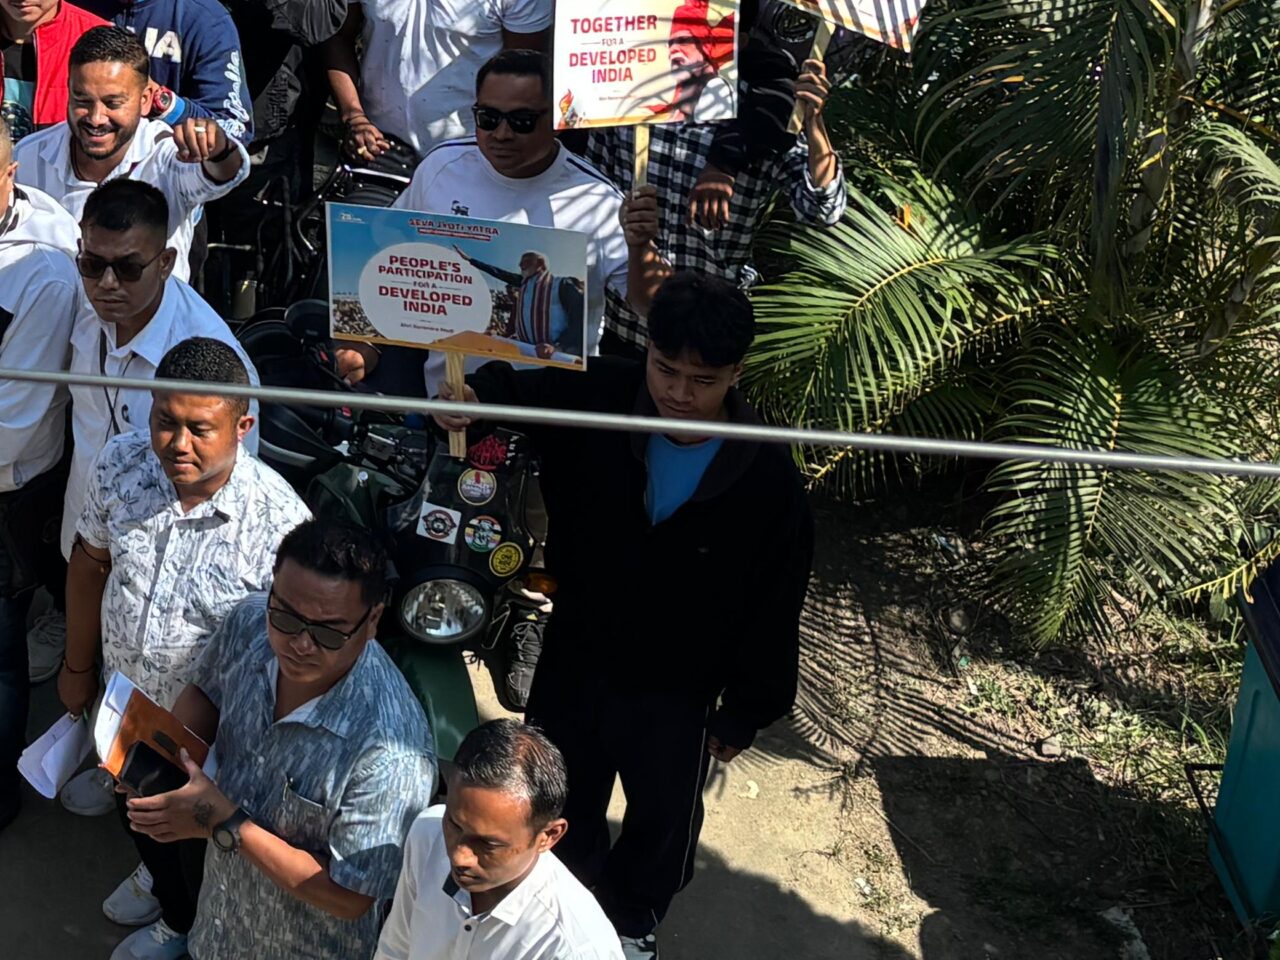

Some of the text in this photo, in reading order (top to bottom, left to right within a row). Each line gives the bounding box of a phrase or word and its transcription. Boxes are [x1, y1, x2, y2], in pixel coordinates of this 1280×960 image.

[571, 15, 658, 34] TOGETHER
[569, 49, 657, 67] DEVELOPED
[592, 67, 633, 83] INDIA
[409, 218, 434, 227] SEVA
[437, 220, 465, 231] JYOTI
[467, 225, 499, 236] YATRA
[389, 255, 461, 273] PEOPLE'S
[378, 266, 472, 284] PARTICIPATION
[378, 286, 472, 307] DEVELOPED
[404, 300, 448, 316] INDIA
